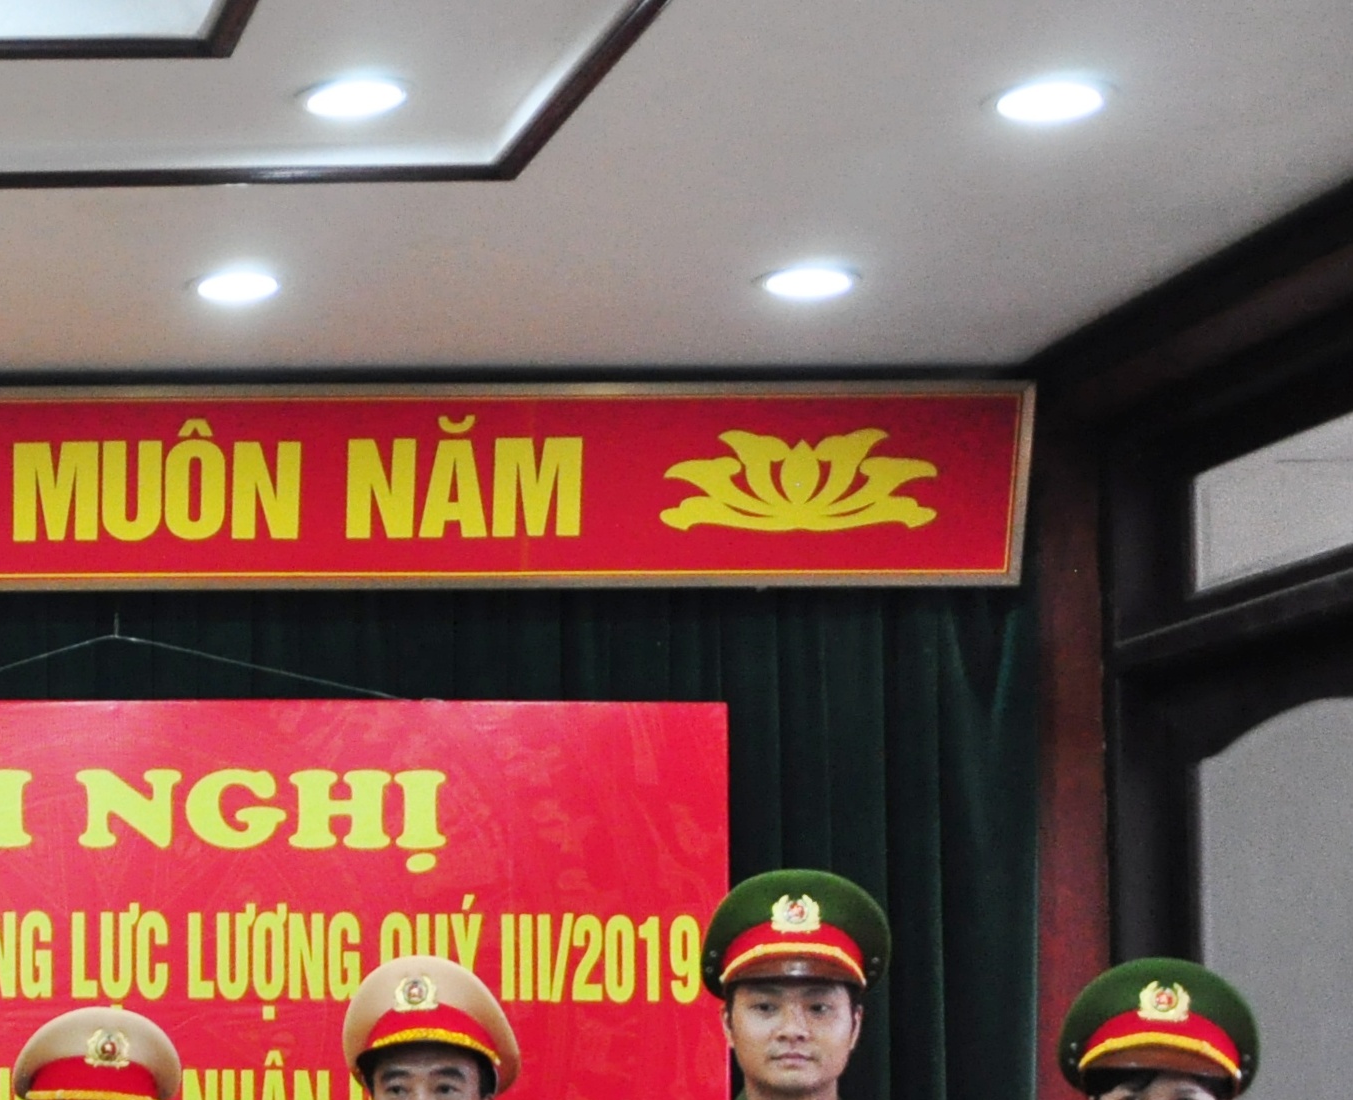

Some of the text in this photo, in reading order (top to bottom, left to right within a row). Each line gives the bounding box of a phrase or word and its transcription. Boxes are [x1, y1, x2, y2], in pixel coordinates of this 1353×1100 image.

[12, 418, 302, 543] MUÔN
[346, 414, 584, 540] NĂM
[76, 767, 448, 874] NGHỊ
[71, 902, 170, 1011] LỰC
[187, 902, 362, 1022] LƯỢNG
[500, 913, 702, 1005] III/2019
